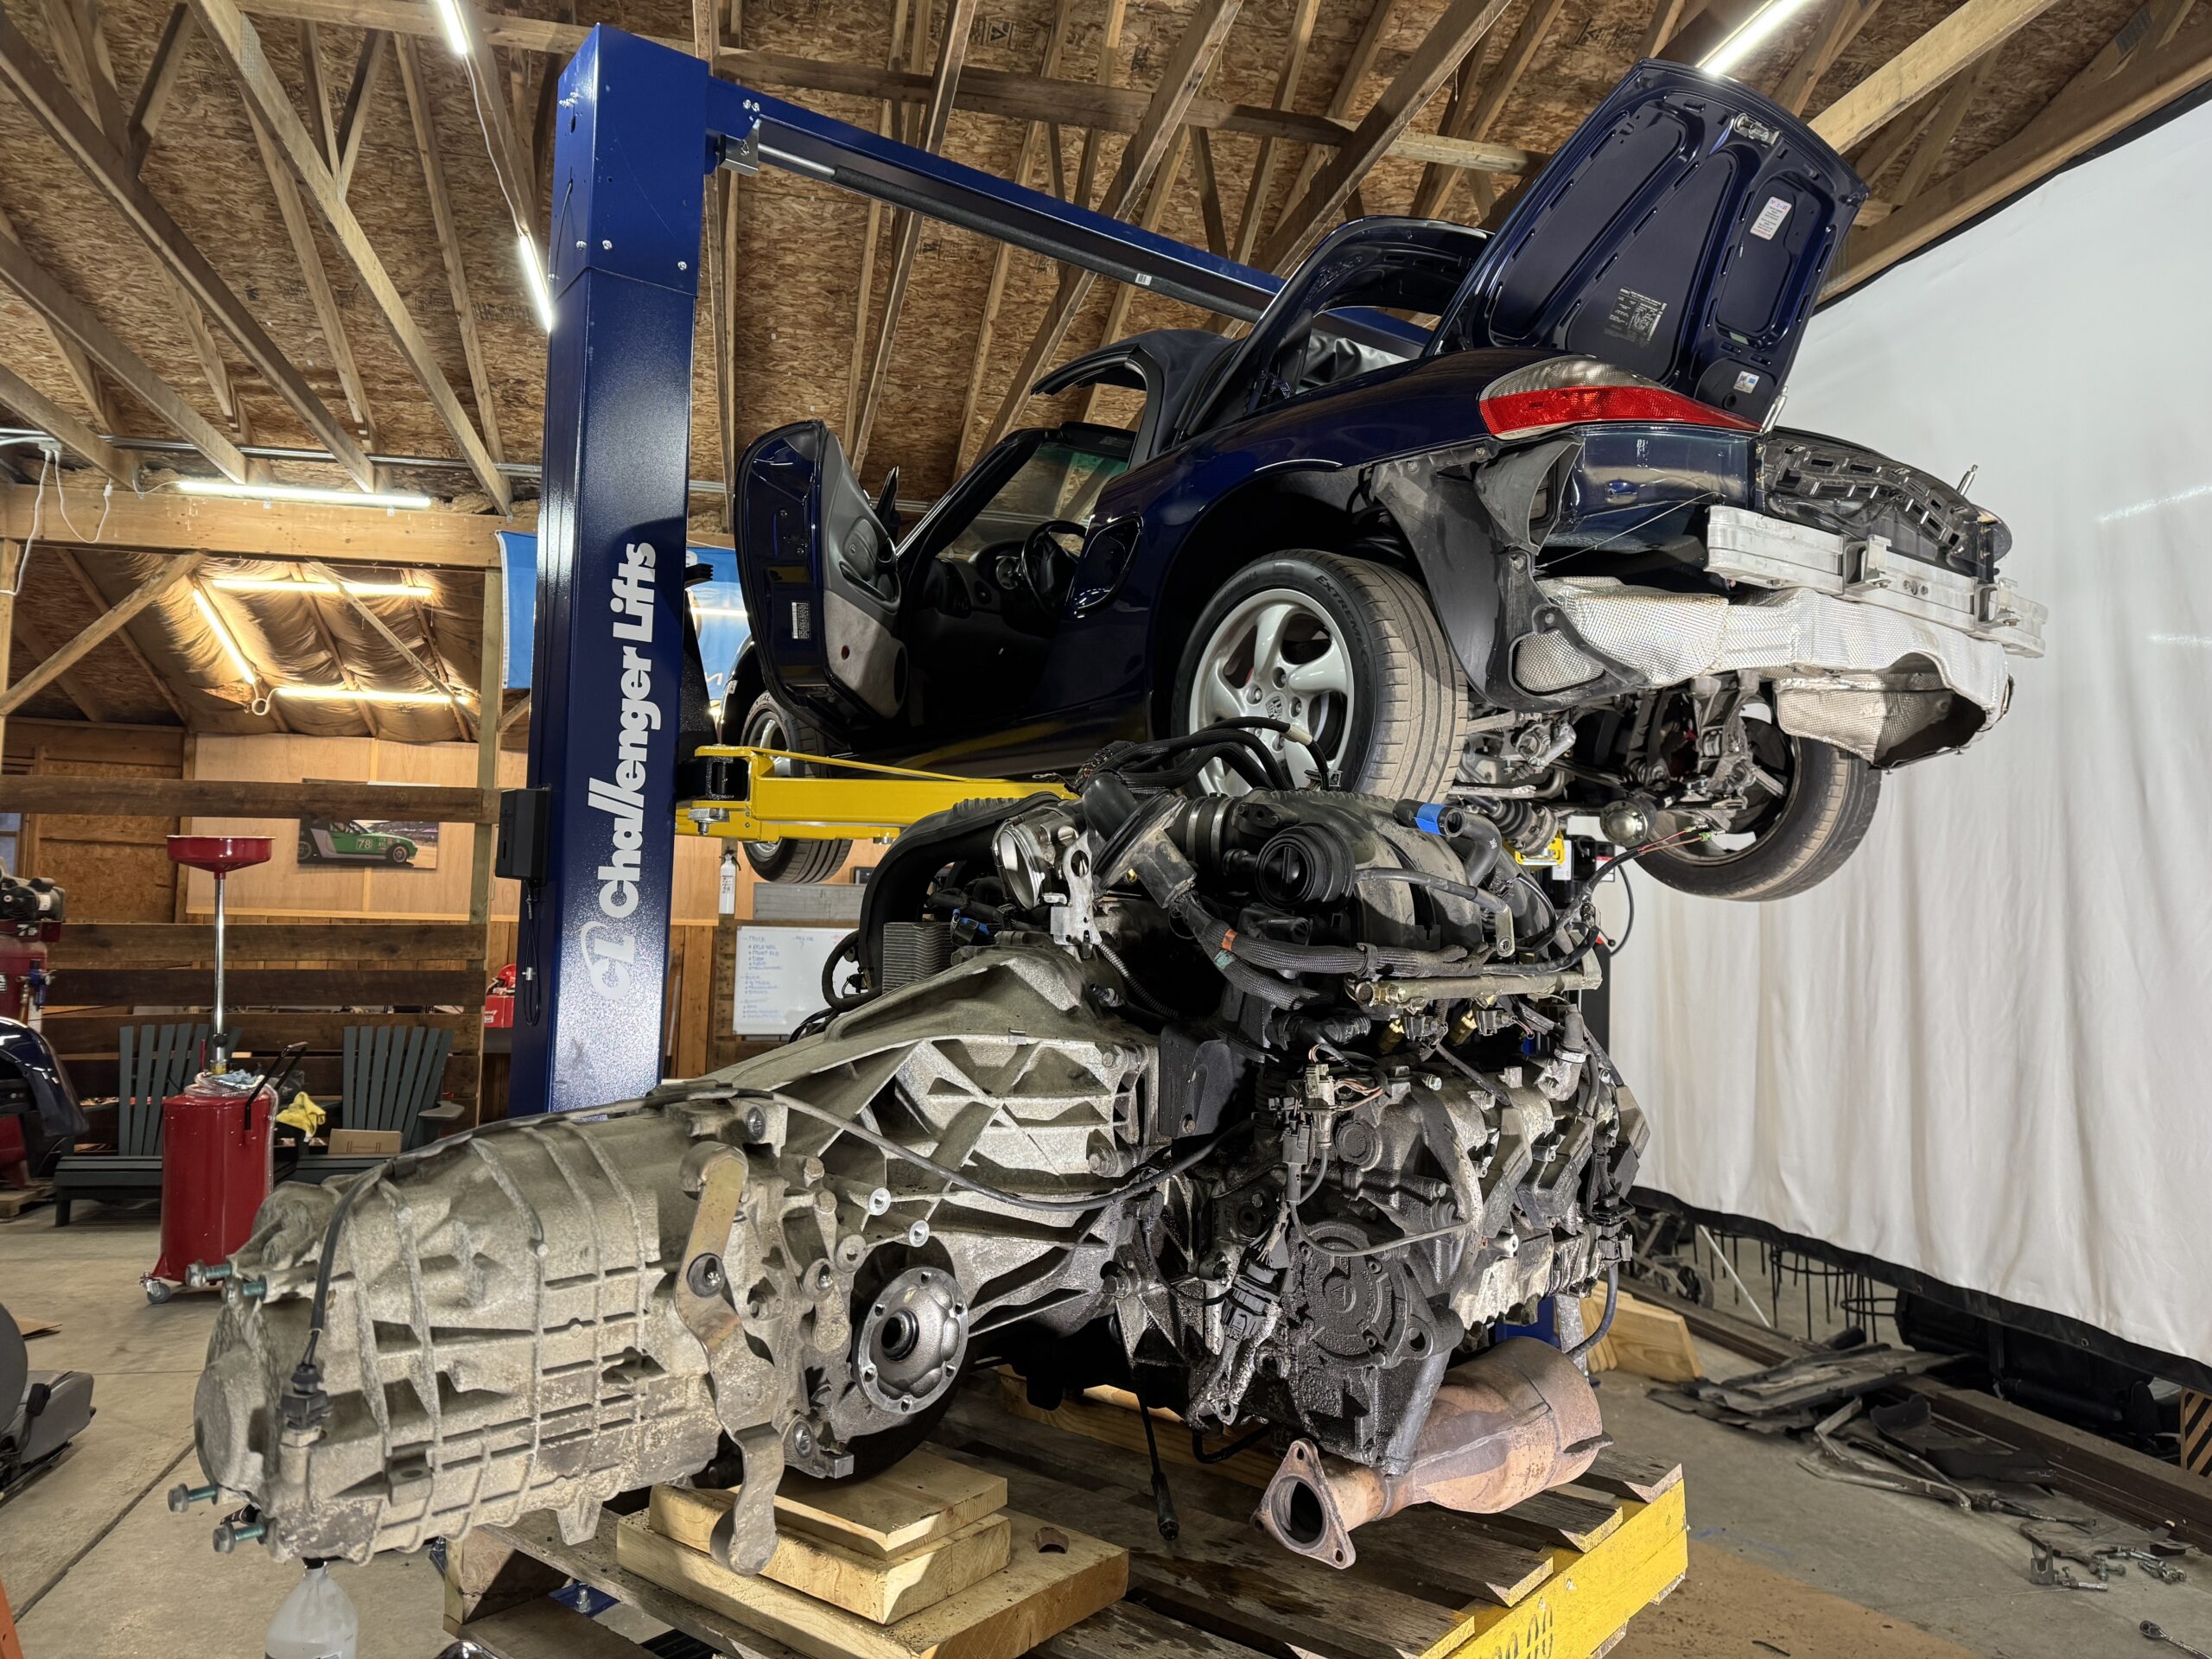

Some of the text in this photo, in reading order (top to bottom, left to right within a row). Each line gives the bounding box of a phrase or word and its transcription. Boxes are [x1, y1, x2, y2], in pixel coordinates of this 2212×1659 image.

[610, 543, 656, 642] Lifts
[588, 645, 661, 918] Challenger
[359, 839, 372, 850] 78
